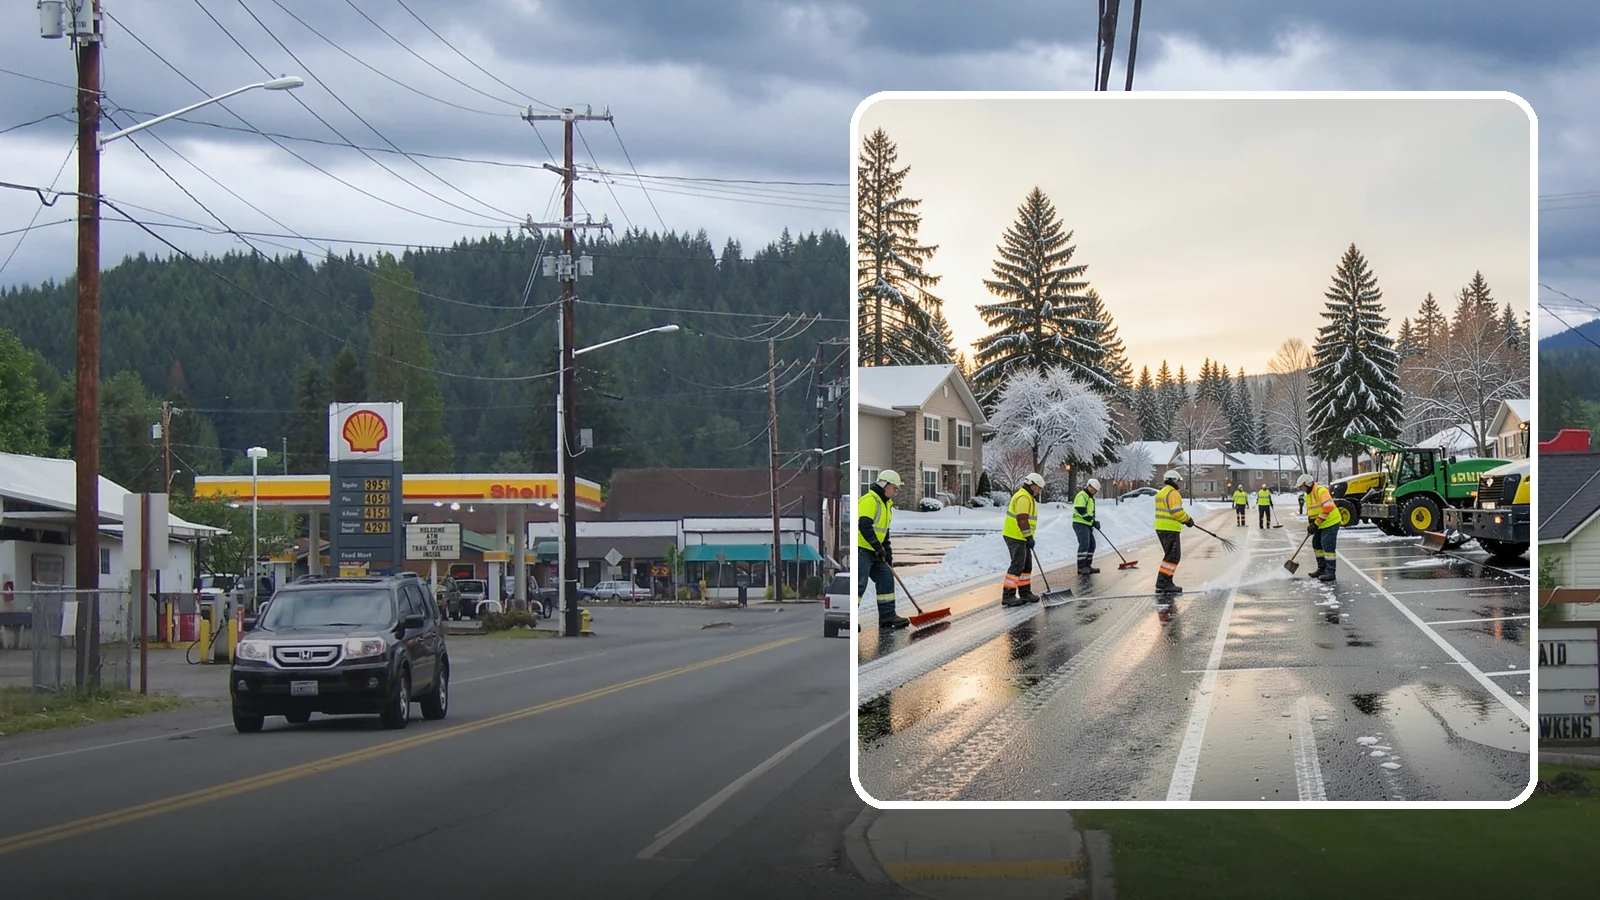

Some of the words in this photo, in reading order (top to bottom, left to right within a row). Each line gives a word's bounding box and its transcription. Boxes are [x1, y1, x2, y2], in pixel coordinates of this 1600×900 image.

[365, 480, 383, 490] 395
[490, 484, 547, 499] Shell
[365, 494, 383, 504] 405
[365, 508, 383, 518] 415
[365, 522, 383, 532] 429
[1538, 642, 1566, 665] AID
